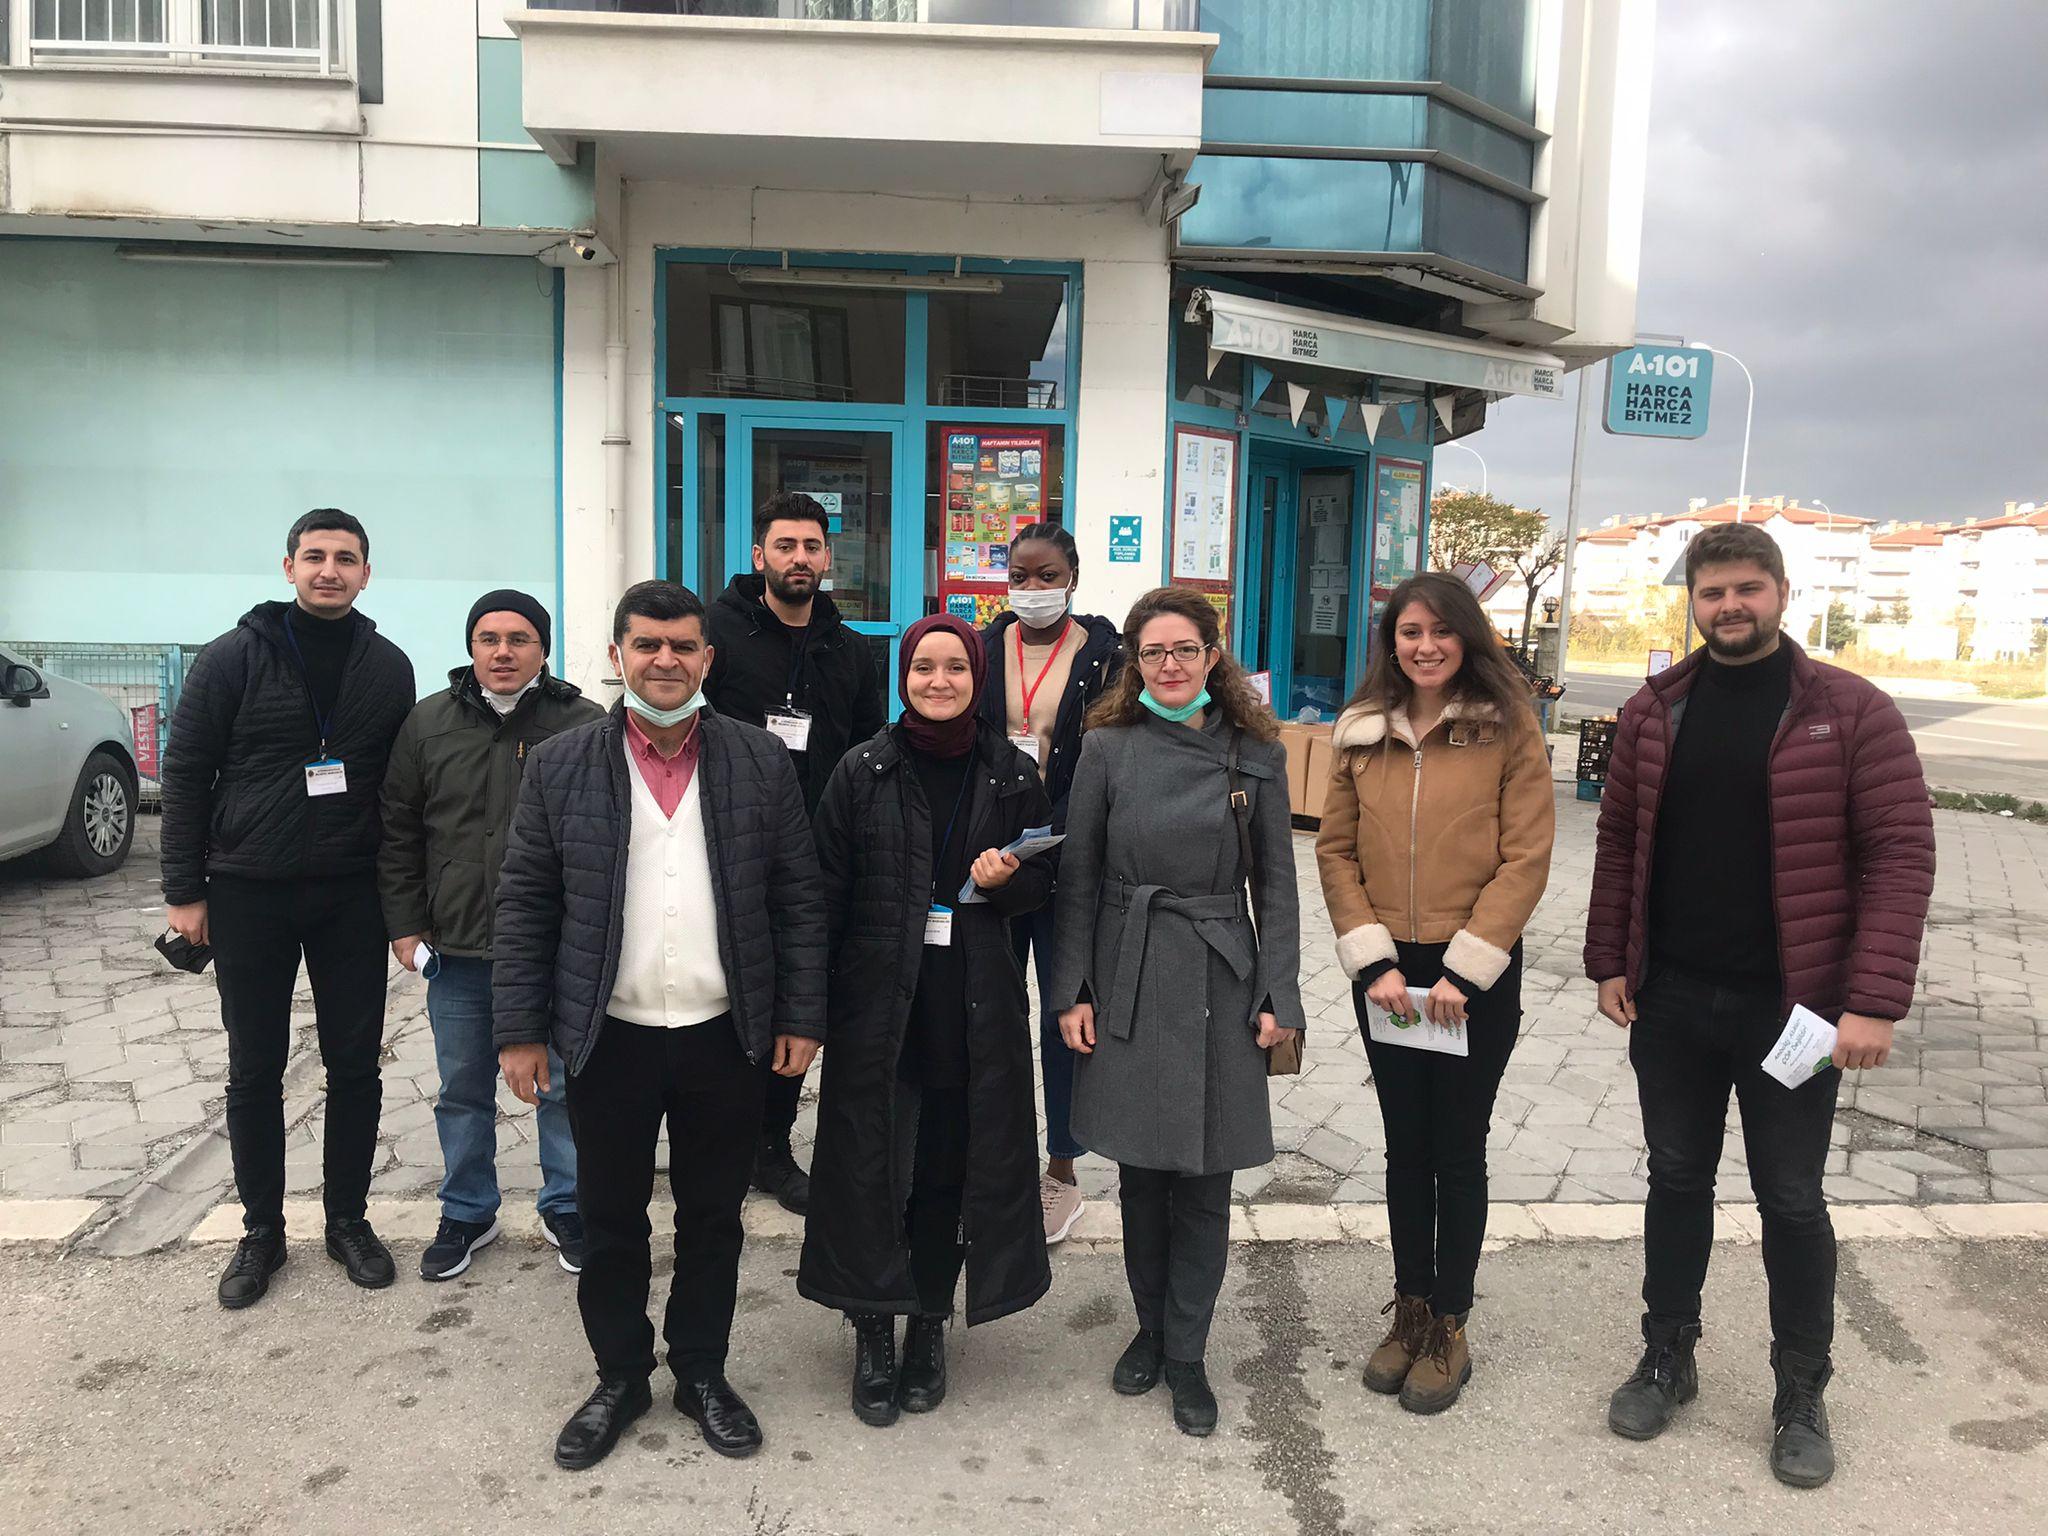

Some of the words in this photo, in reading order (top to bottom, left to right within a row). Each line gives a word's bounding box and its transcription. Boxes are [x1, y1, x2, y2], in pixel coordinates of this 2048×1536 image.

[1292, 329, 1318, 341] HARCA
[1292, 338, 1318, 349] HARCA
[1534, 368, 1554, 377] HARCA
[1534, 376, 1554, 385] HARCA
[1626, 382, 1693, 399] HARCA
[1625, 396, 1692, 412] HARCA
